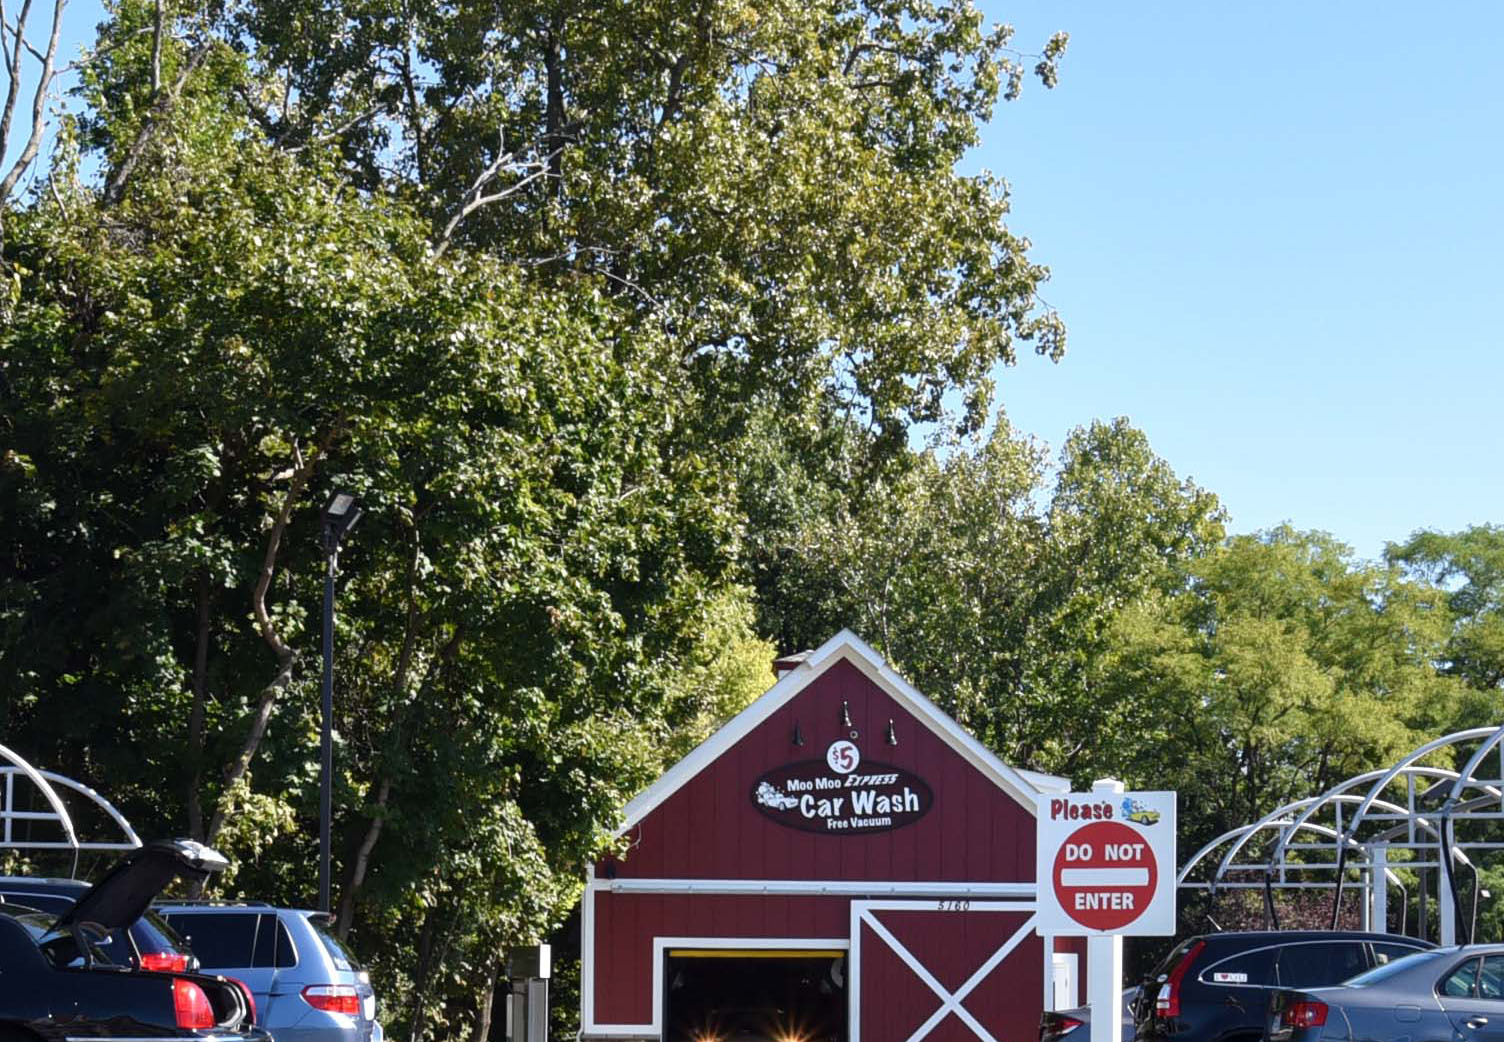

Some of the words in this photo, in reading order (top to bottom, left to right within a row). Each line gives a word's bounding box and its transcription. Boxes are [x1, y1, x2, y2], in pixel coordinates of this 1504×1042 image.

[832, 745, 854, 770] $5
[786, 779, 813, 792] Moo
[815, 777, 842, 790] Moo
[844, 773, 899, 787] EXPRESS
[800, 794, 845, 819] Car
[850, 786, 920, 816] Wash
[1050, 798, 1114, 821] Please
[826, 818, 849, 830] Free
[849, 816, 892, 829] Vacuum
[1065, 843, 1093, 861] DO
[1104, 843, 1145, 861] NOT
[1074, 892, 1135, 910] ENTER
